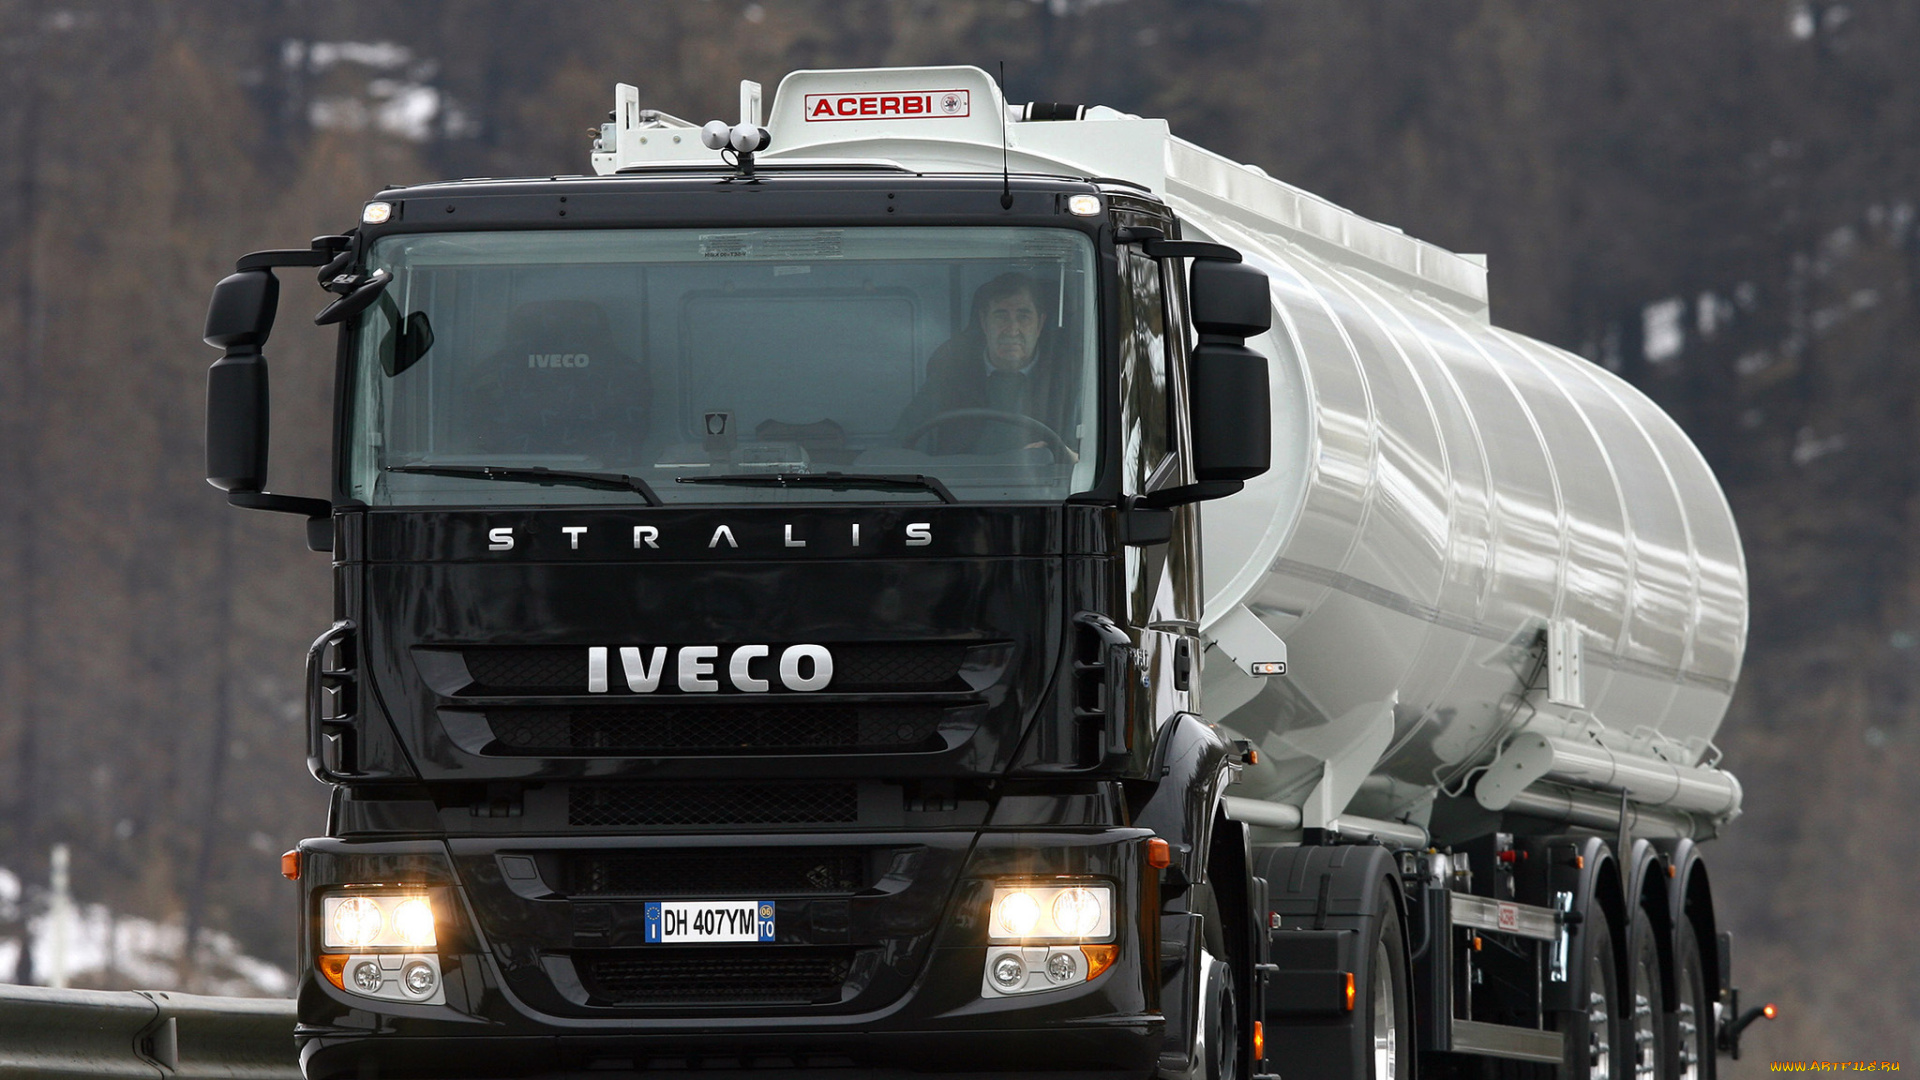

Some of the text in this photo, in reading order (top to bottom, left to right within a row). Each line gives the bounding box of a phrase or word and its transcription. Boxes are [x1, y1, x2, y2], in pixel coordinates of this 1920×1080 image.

[812, 96, 932, 117] ACERBI
[528, 353, 590, 368] IVECO
[488, 523, 932, 551] STRALIS
[588, 644, 834, 693] IVECO
[664, 909, 688, 936] DH
[693, 908, 755, 936] 407YM
[758, 921, 774, 938] TO
